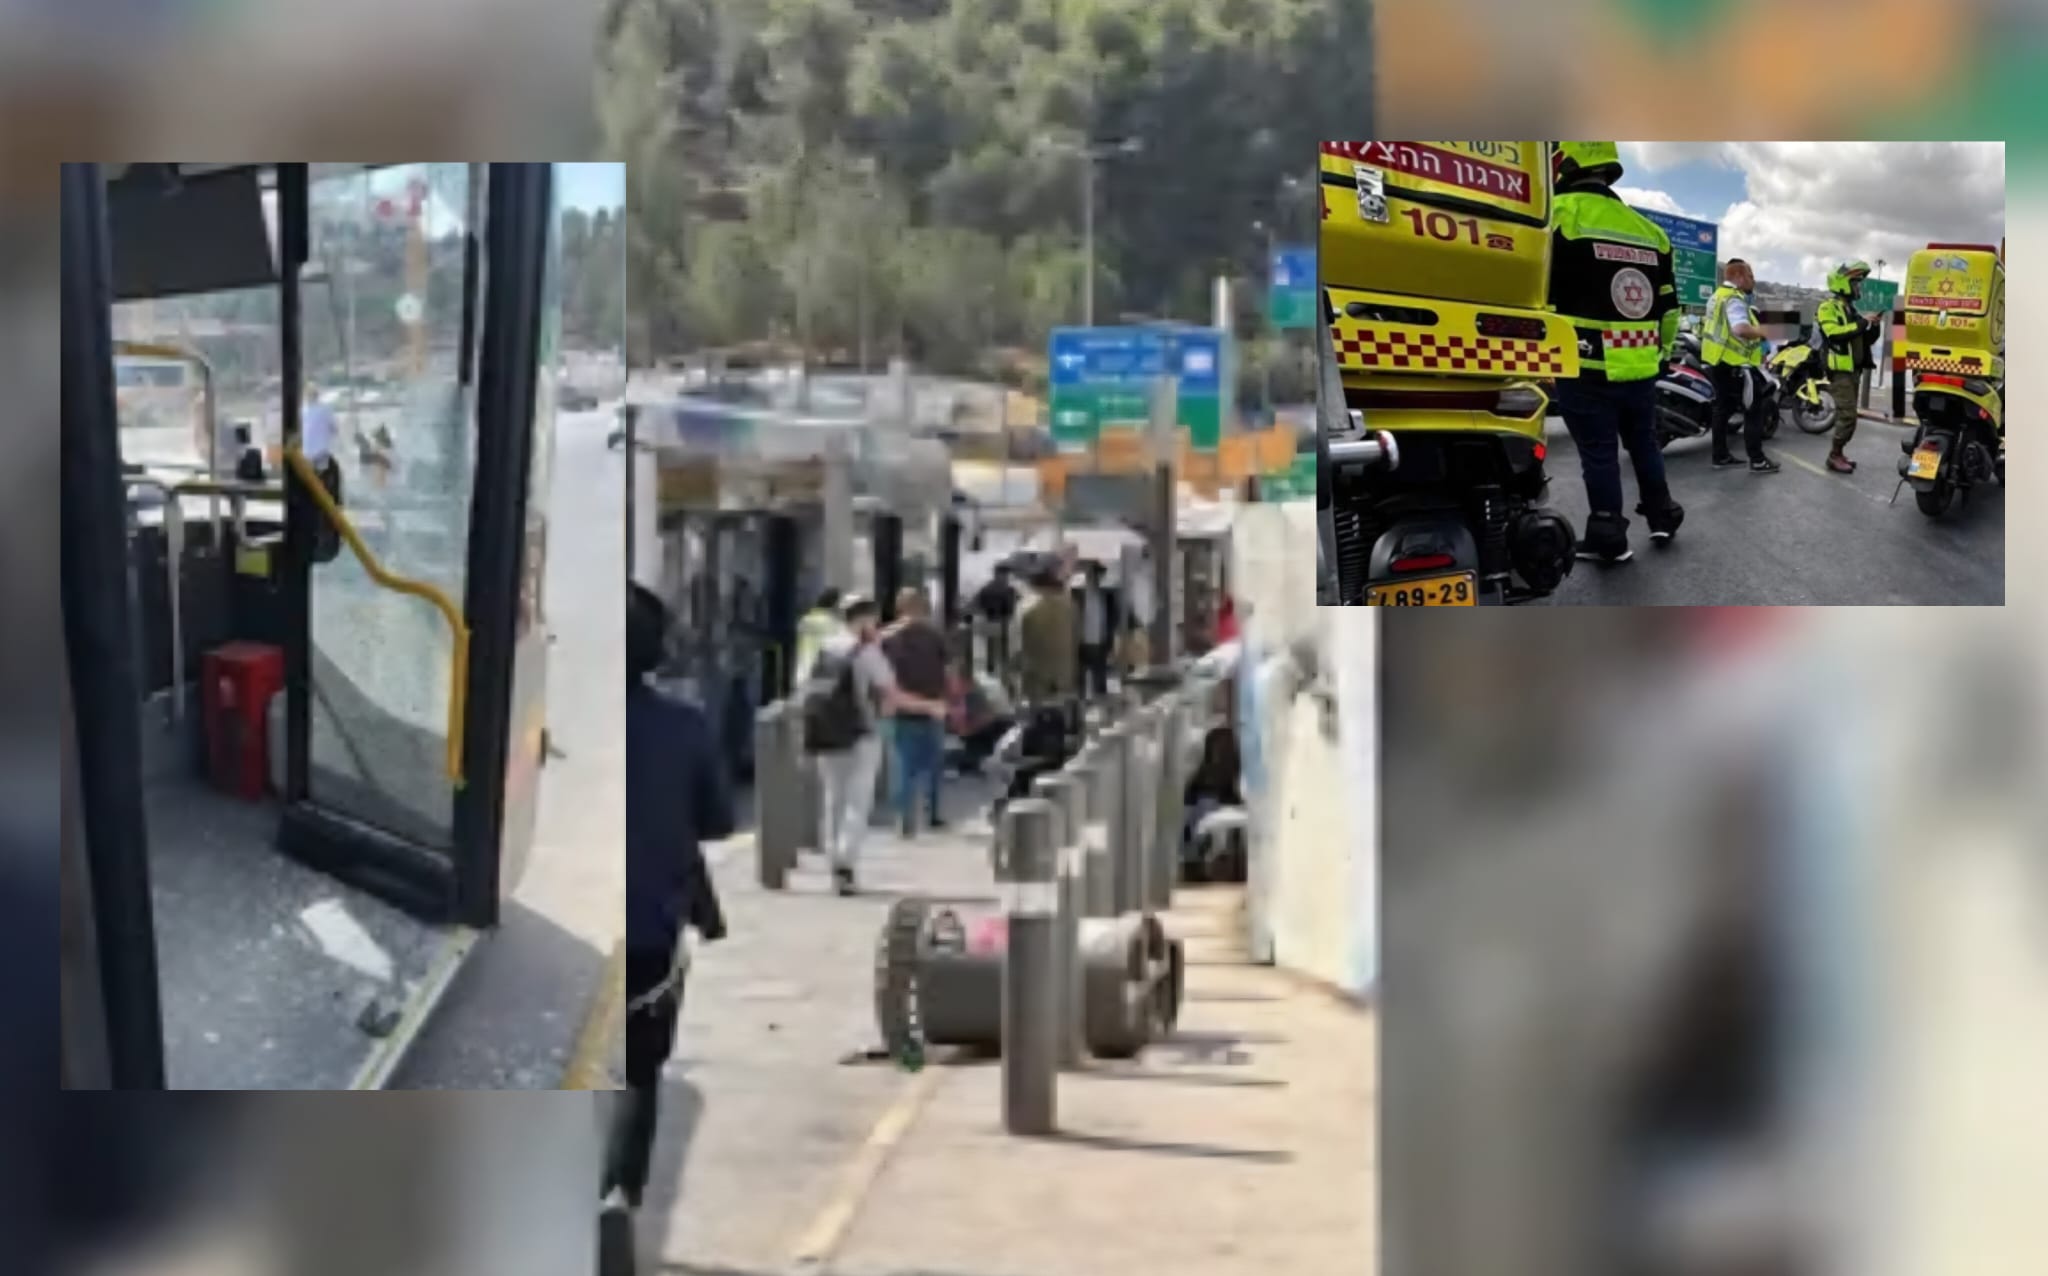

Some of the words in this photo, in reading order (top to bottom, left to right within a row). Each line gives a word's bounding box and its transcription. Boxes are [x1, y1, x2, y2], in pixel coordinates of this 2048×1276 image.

[1453, 160, 1523, 195] ארגון
[1401, 207, 1480, 245] 101
[1950, 317, 1968, 328] 101
